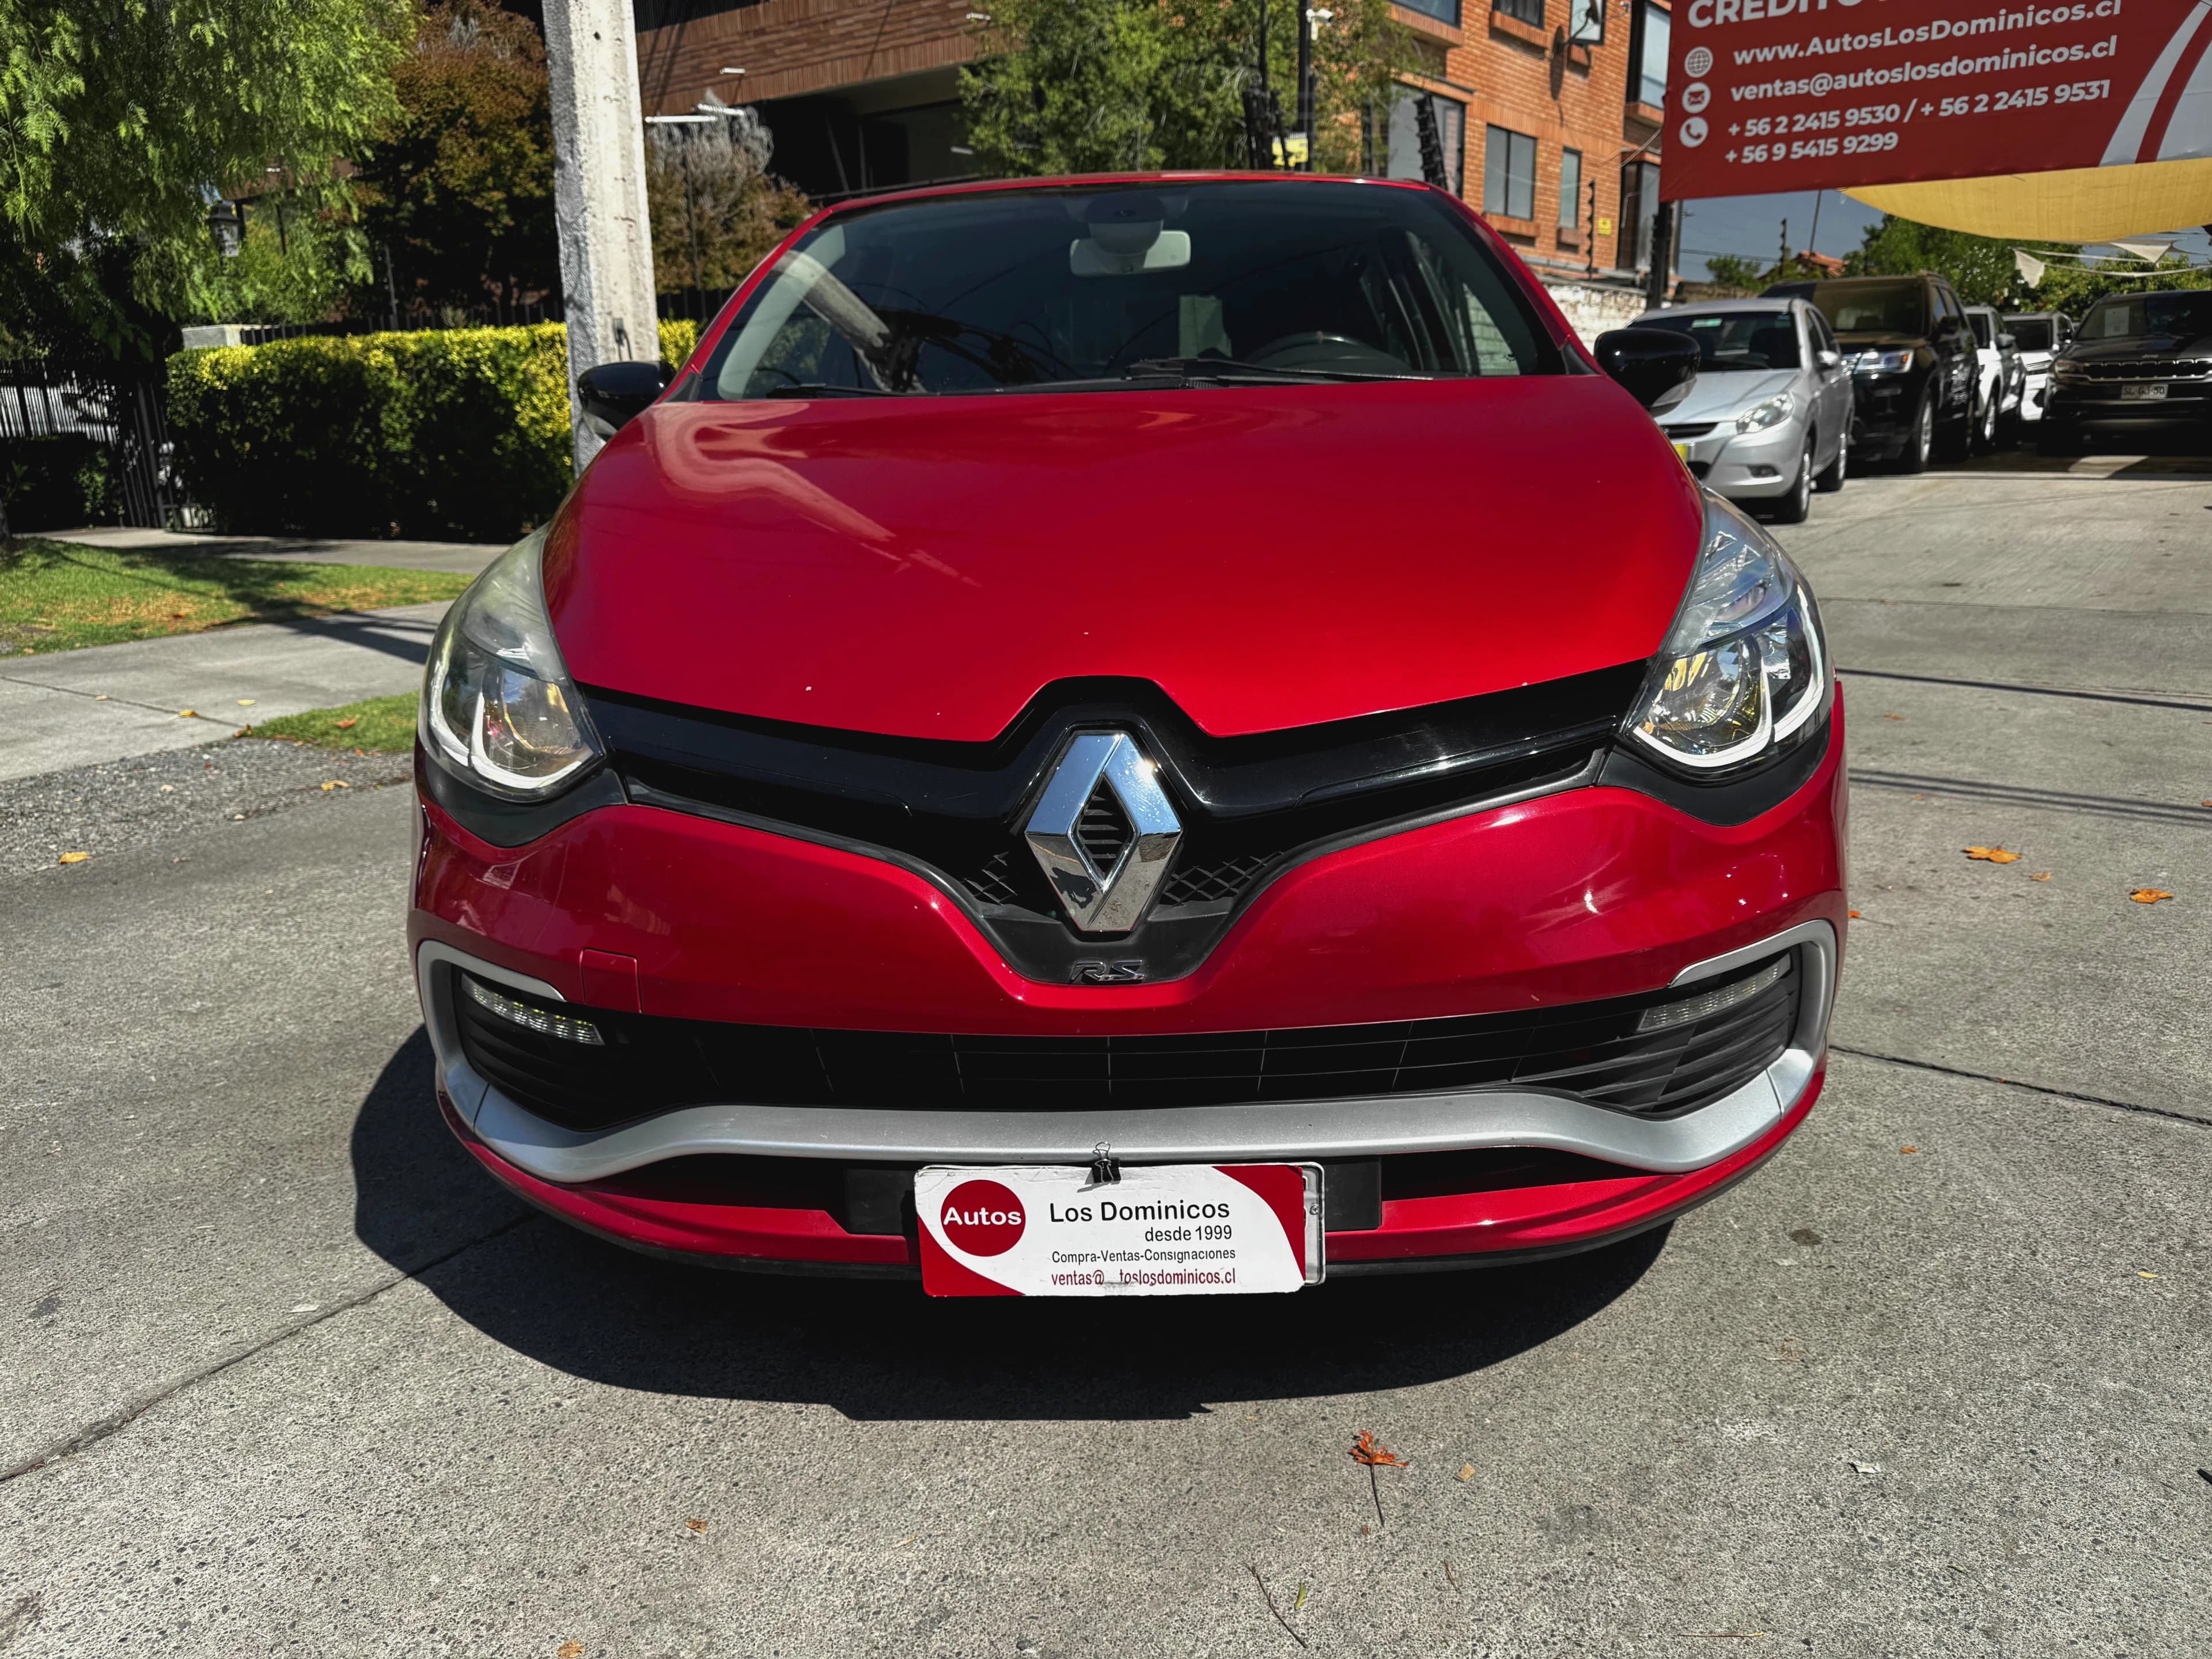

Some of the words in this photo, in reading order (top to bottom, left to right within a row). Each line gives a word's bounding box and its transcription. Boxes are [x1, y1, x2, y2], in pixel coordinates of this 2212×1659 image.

[1688, 0, 1862, 28] CRED
[1733, 0, 2121, 65] www.AutosLosDominicos.cl
[1730, 35, 2118, 101] ventas@autoslosdominicos.cl
[1728, 123, 1740, 136] +
[1744, 117, 1771, 137] 56
[1774, 115, 1789, 134] 2
[1791, 110, 1840, 132] 2415
[1844, 104, 1900, 127] 9530
[1903, 98, 1918, 123] /
[1920, 103, 1934, 116] +
[1938, 96, 1969, 117] 56
[1973, 93, 1989, 113] 2
[1993, 86, 2049, 111] 2415
[2054, 79, 2111, 104] 9531
[1725, 150, 1738, 162] +
[1741, 144, 1768, 164] 56
[1772, 142, 1787, 161] 9
[1790, 137, 1839, 160] 5415
[1843, 131, 1899, 154] 9299
[944, 1207, 1022, 1225] Autos
[1050, 1203, 1093, 1222] Los
[1101, 1199, 1230, 1221] Dominicos
[1145, 1226, 1191, 1242] desde
[1195, 1225, 1232, 1241] 1999
[1052, 1248, 1236, 1266] Compra-Ventas-Consignaciones
[1051, 1267, 1236, 1286] ventas@toslosdominicos.cl
